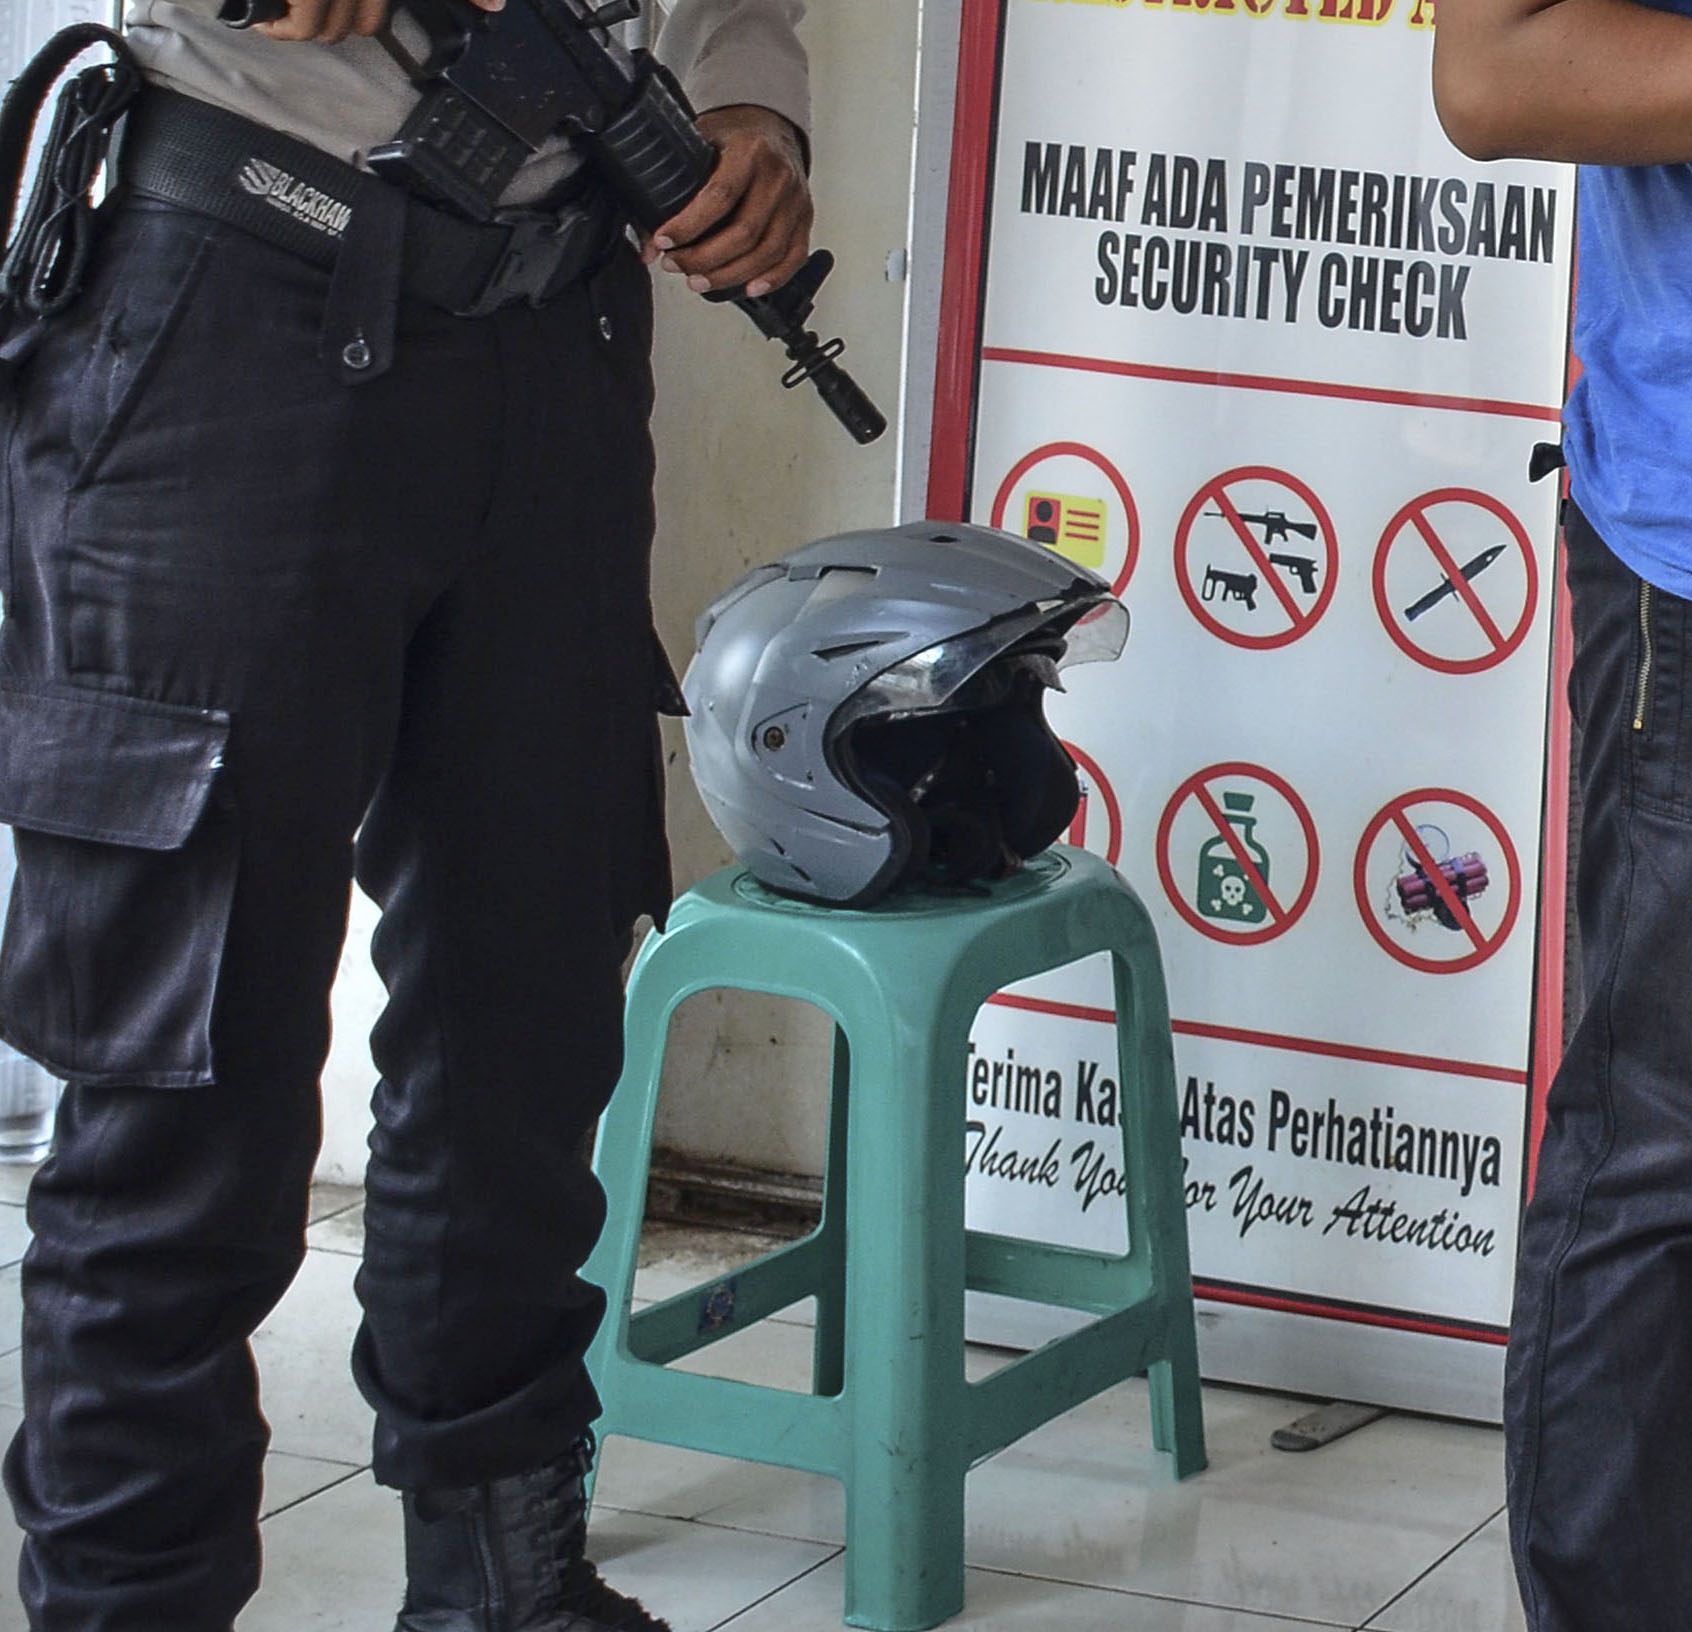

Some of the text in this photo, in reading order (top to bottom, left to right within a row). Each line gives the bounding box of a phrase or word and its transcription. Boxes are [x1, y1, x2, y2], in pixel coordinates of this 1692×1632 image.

[1020, 140, 1557, 265] MAAF ADA PEMERIKSAAN
[1095, 230, 1472, 341] SECURITY CHECK
[1075, 1060, 1122, 1128] Ka
[1181, 1076, 1256, 1149] Atas
[1268, 1089, 1502, 1197] Perhatiannya
[1182, 1156, 1217, 1212] or
[1229, 1164, 1315, 1238] Your
[1322, 1183, 1495, 1258] Attention
